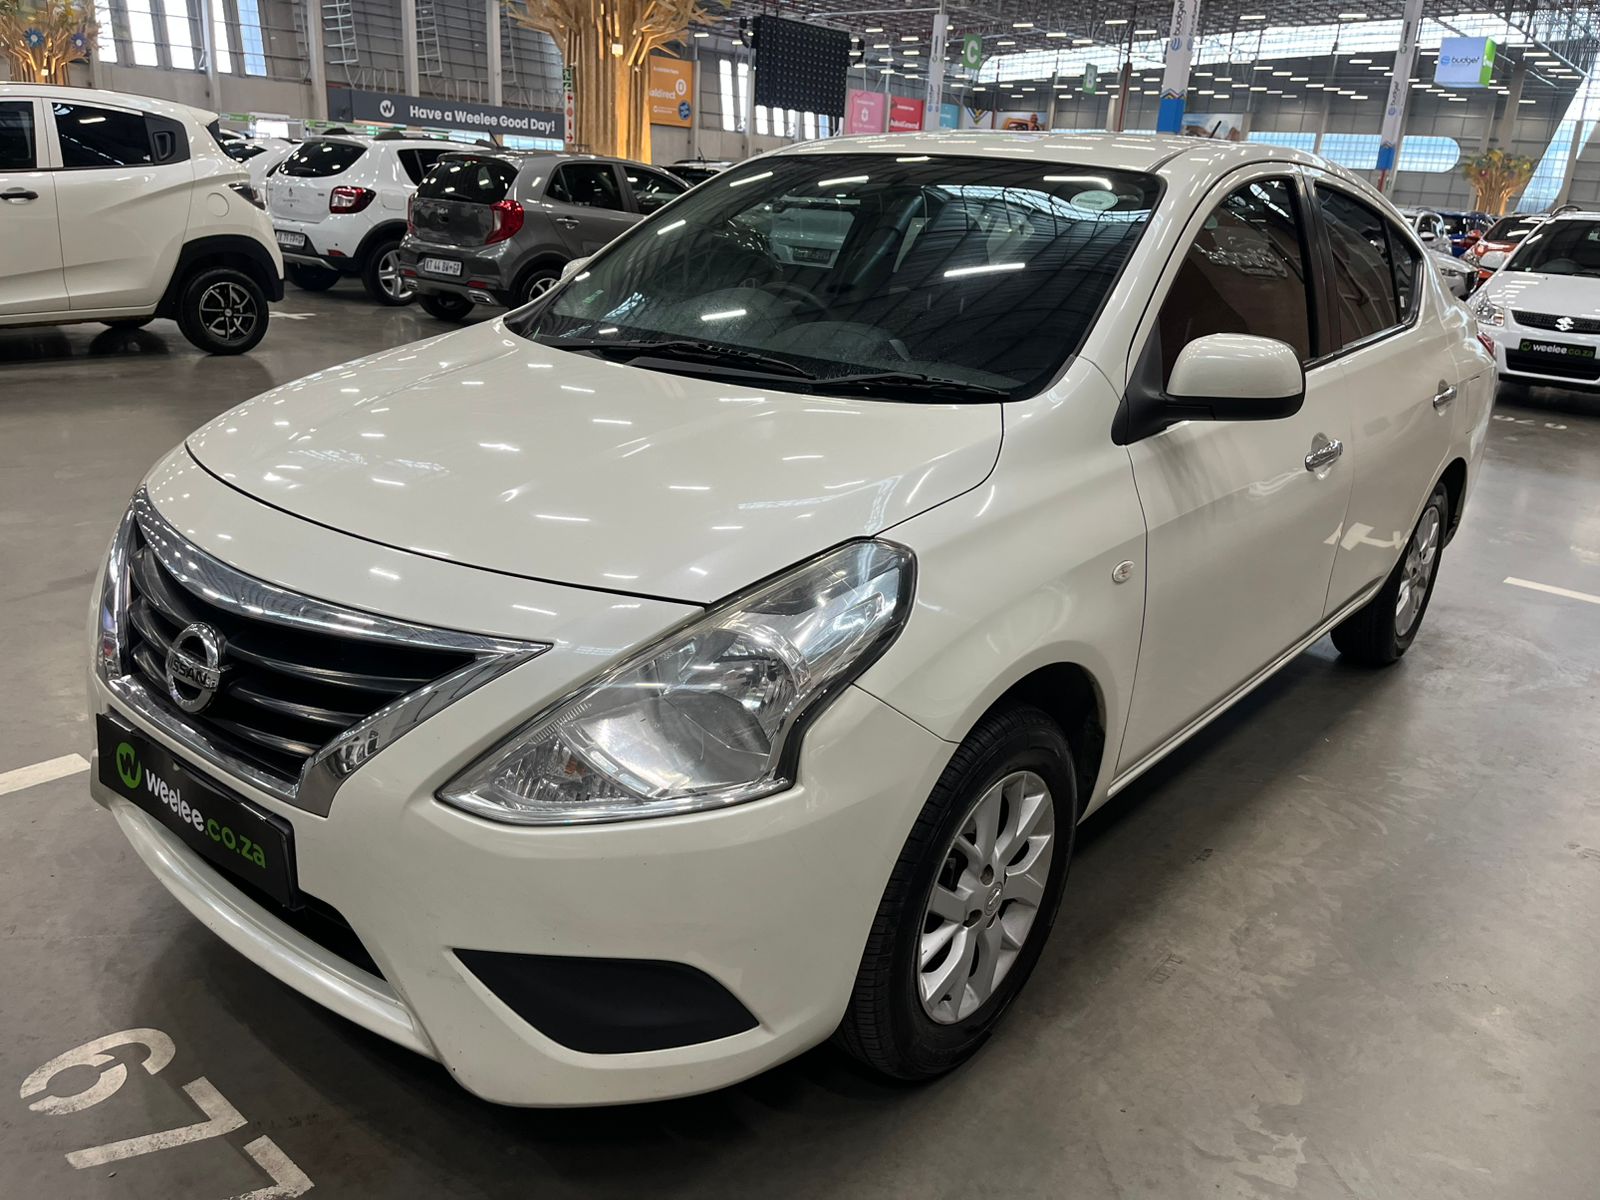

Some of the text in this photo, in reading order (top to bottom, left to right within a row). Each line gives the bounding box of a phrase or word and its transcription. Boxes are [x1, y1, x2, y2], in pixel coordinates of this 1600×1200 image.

[966, 40, 979, 64] C
[1450, 56, 1480, 66] budget
[409, 105, 442, 121] Have
[444, 112, 452, 122] a
[454, 110, 498, 126] Weelee
[499, 113, 529, 130] Good
[530, 117, 555, 134] Day!
[145, 769, 266, 869] weelee.co.za
